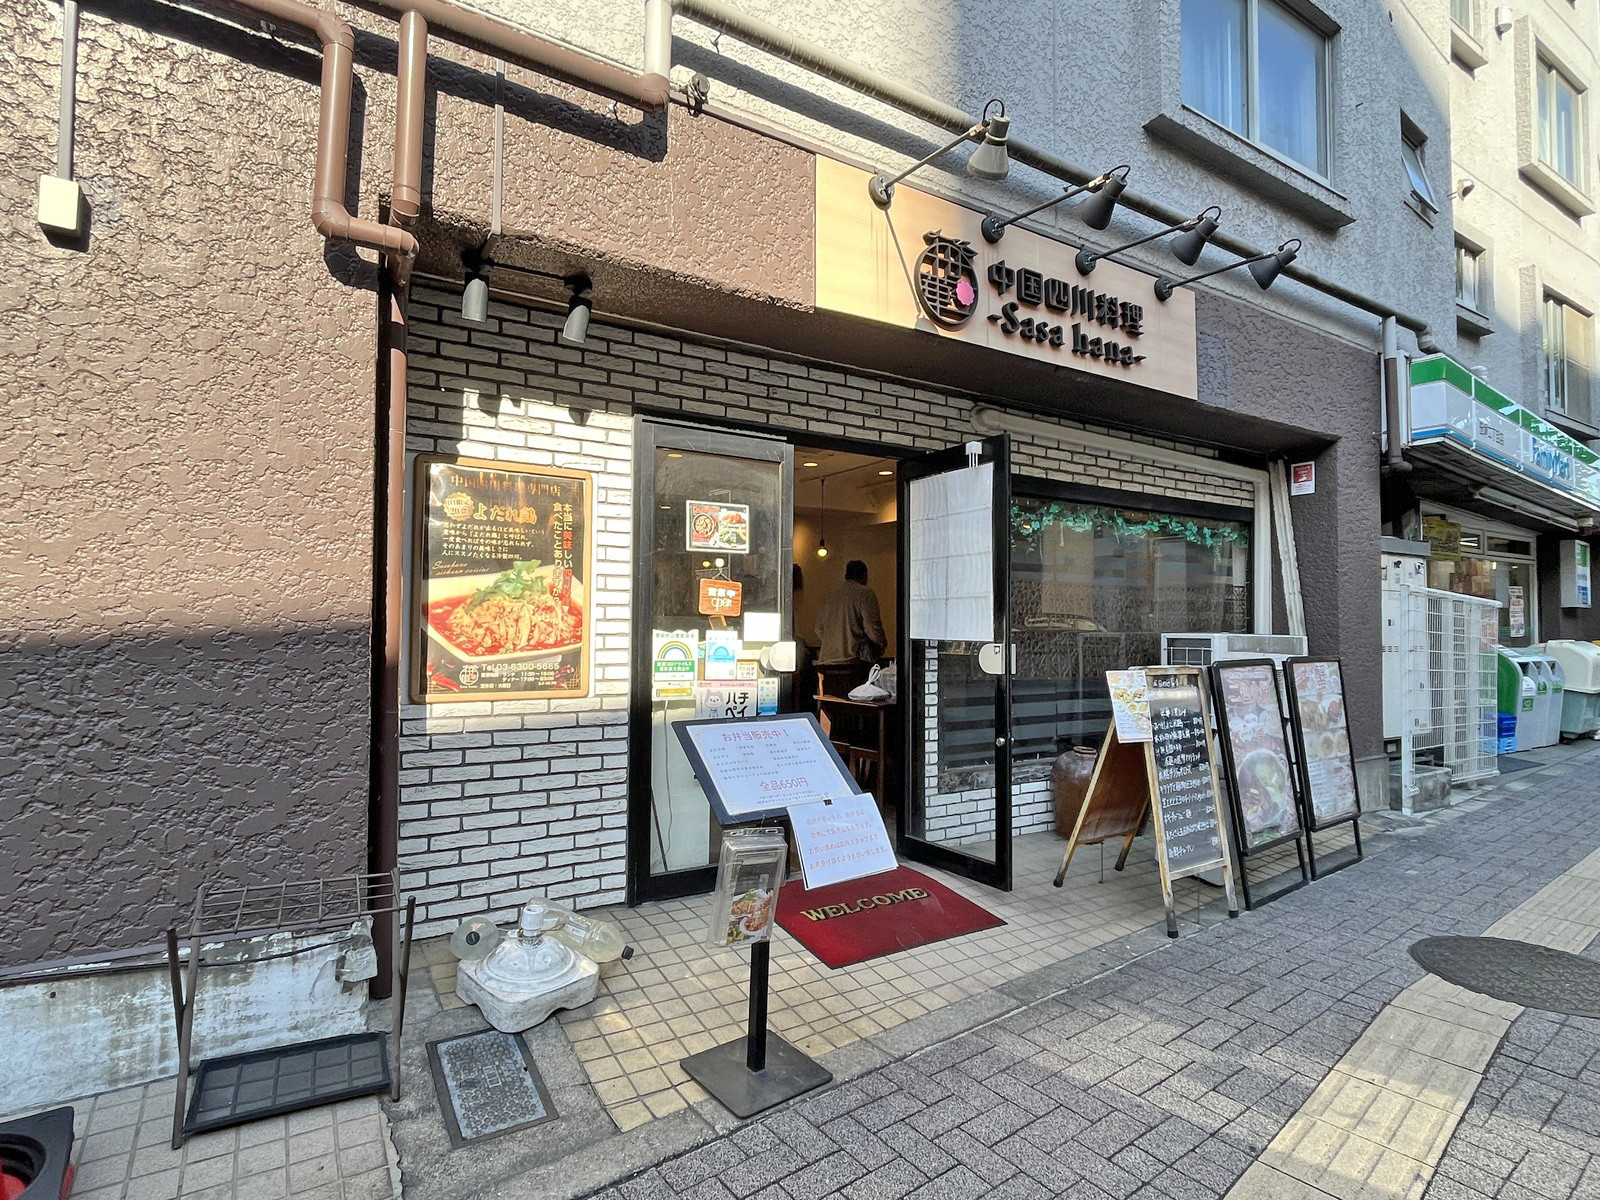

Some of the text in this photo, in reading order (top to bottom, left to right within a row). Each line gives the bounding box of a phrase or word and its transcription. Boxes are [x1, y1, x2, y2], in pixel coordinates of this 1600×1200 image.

[988, 260, 1144, 336] 中国四川料理
[473, 502, 537, 525] よだれ鶏
[707, 587, 736, 598] 営業中
[726, 692, 749, 705] ハチ
[725, 705, 748, 718] ペイ
[721, 729, 789, 742] お弁当販売中！
[759, 776, 809, 792] 全品650円
[800, 887, 930, 922] WELCOME
